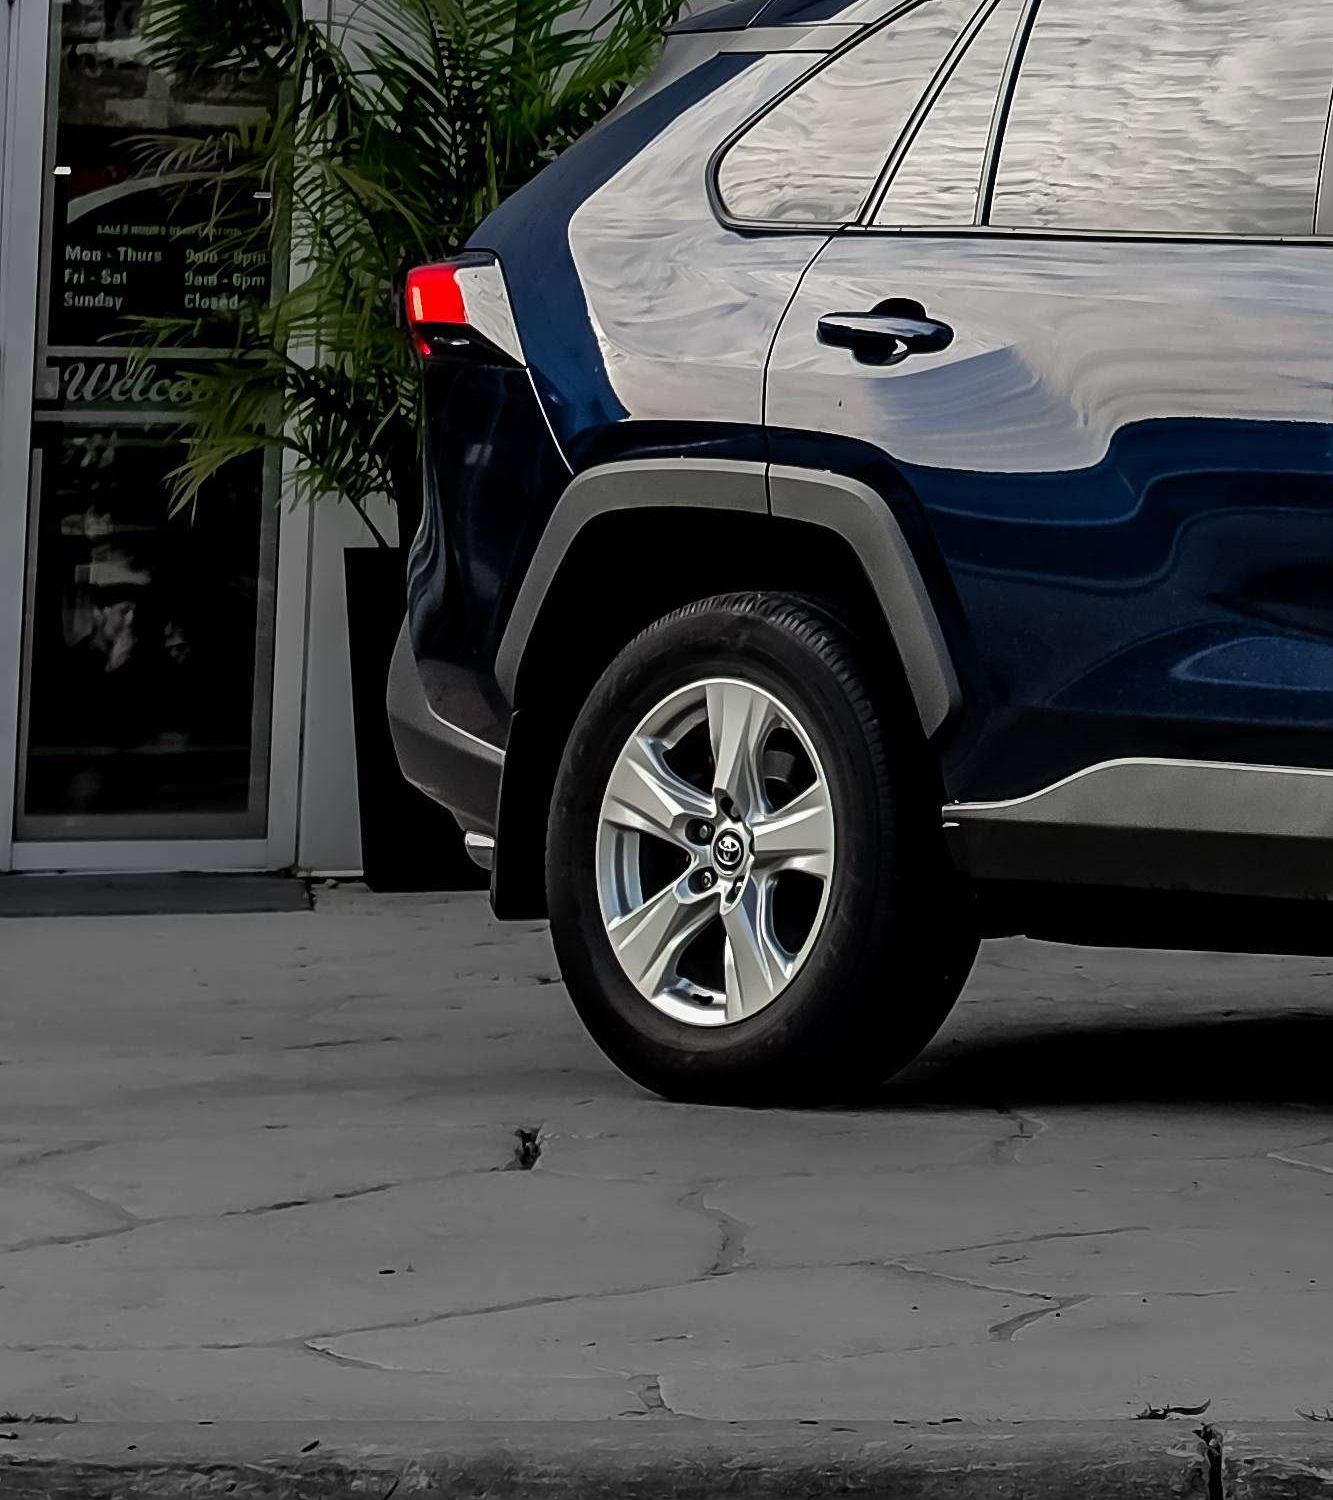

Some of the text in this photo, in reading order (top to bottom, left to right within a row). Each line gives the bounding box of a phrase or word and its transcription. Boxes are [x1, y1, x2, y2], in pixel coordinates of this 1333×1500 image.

[65, 245, 102, 261] Mon
[115, 246, 163, 262] Thurs
[64, 268, 86, 284] Fri
[100, 268, 128, 285] Sat
[63, 291, 124, 311] Sunday
[184, 291, 240, 310] Closed
